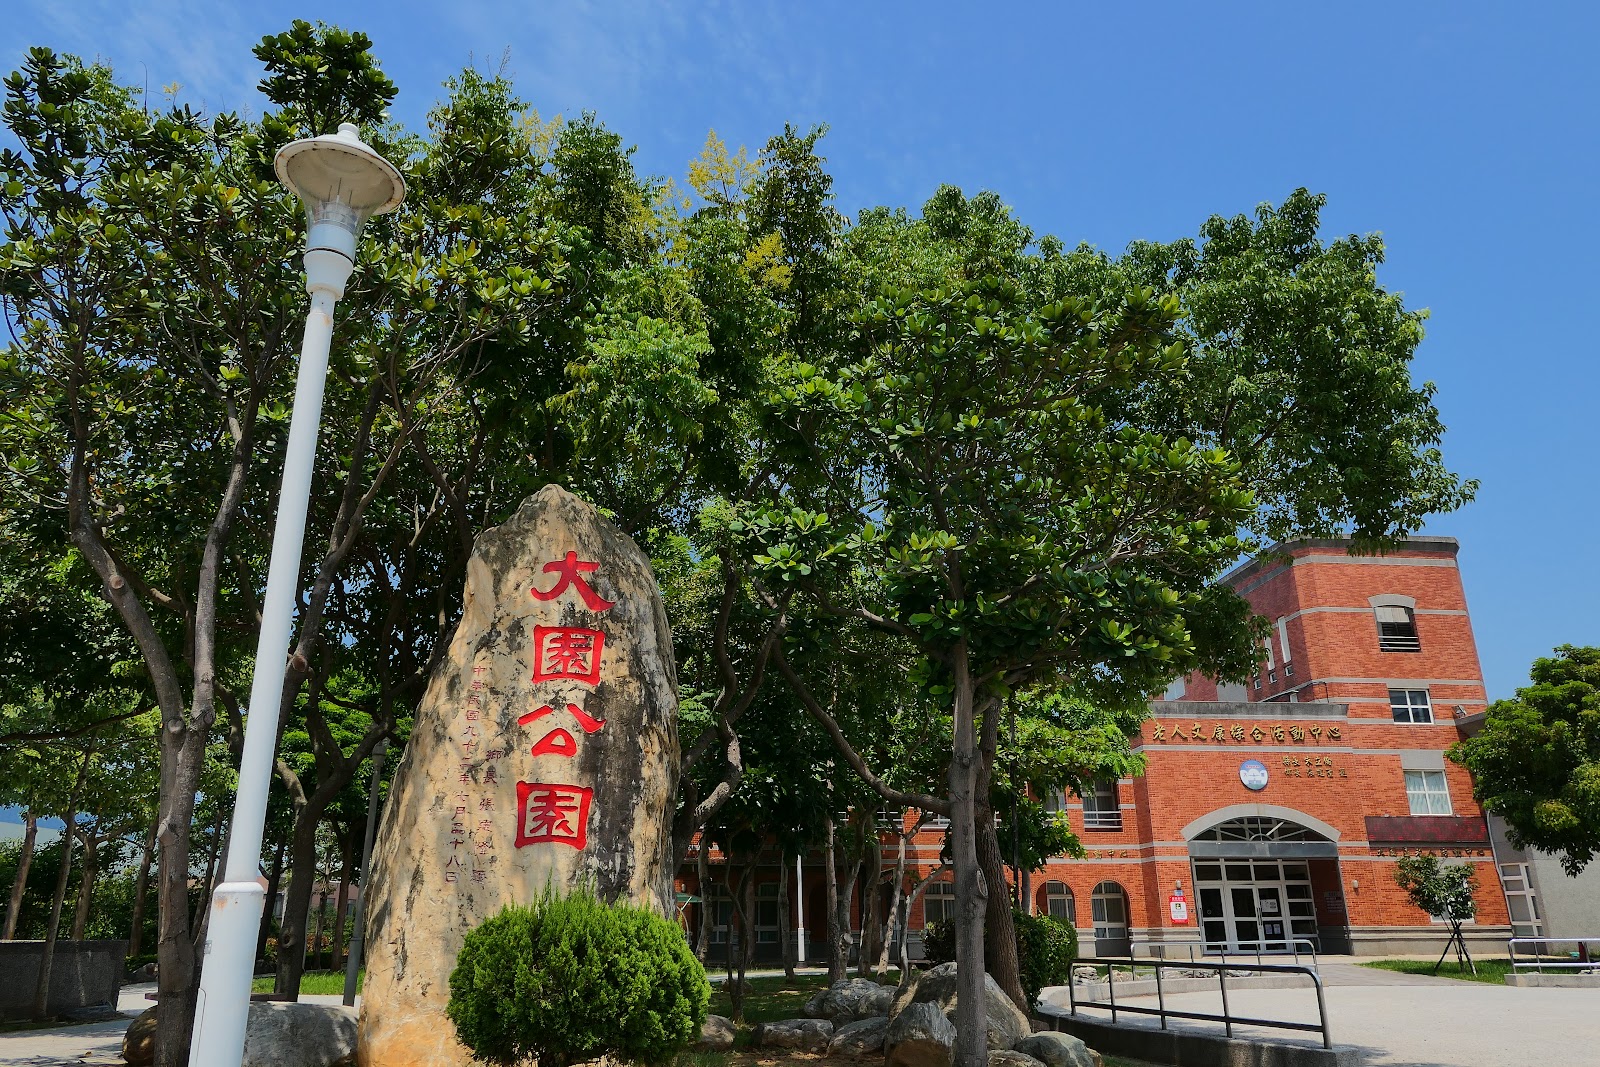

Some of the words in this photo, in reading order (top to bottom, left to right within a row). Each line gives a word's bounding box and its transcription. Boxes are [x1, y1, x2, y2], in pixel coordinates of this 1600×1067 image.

[513, 550, 615, 850] 大園公園
[1153, 723, 1342, 743] 老人文康綜合活動中心
